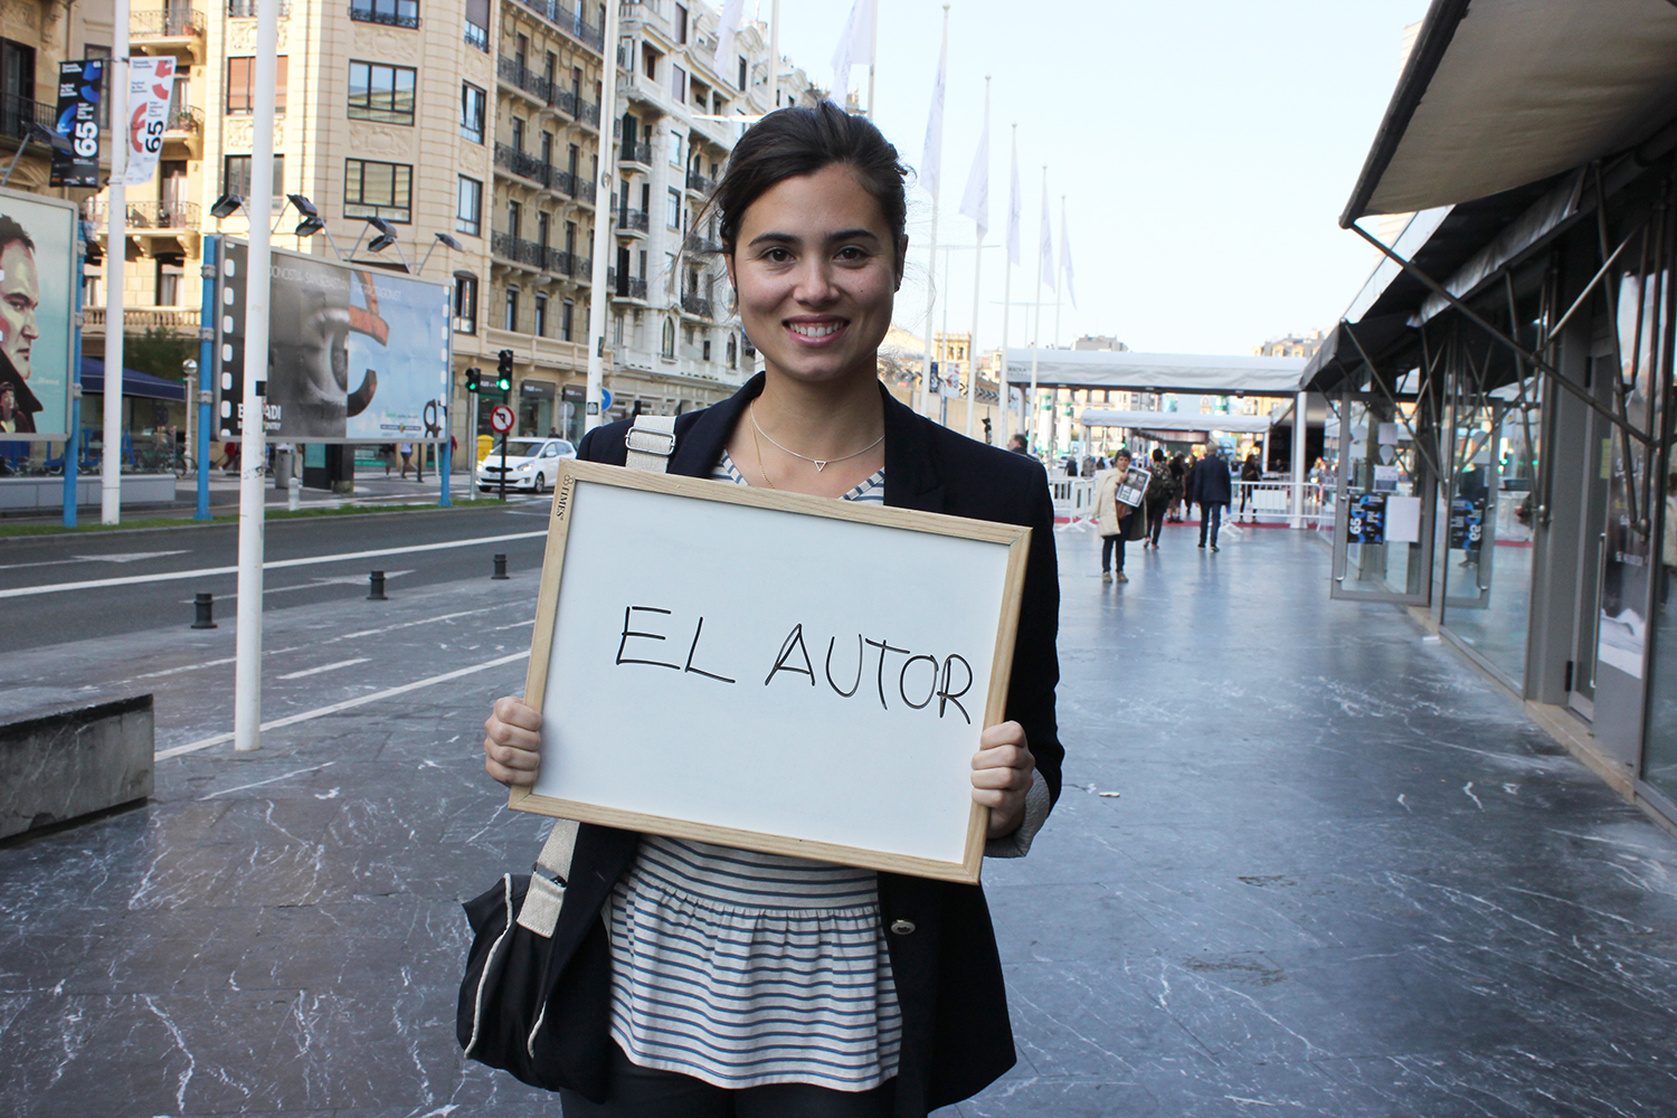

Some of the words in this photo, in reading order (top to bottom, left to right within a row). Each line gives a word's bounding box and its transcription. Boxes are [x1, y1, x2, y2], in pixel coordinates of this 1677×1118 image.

[74, 121, 99, 157] 65
[145, 120, 164, 153] 65
[237, 402, 282, 420] EADI
[1350, 517, 1363, 535] 65
[616, 604, 736, 684] EL
[765, 623, 974, 725] AUTOR
